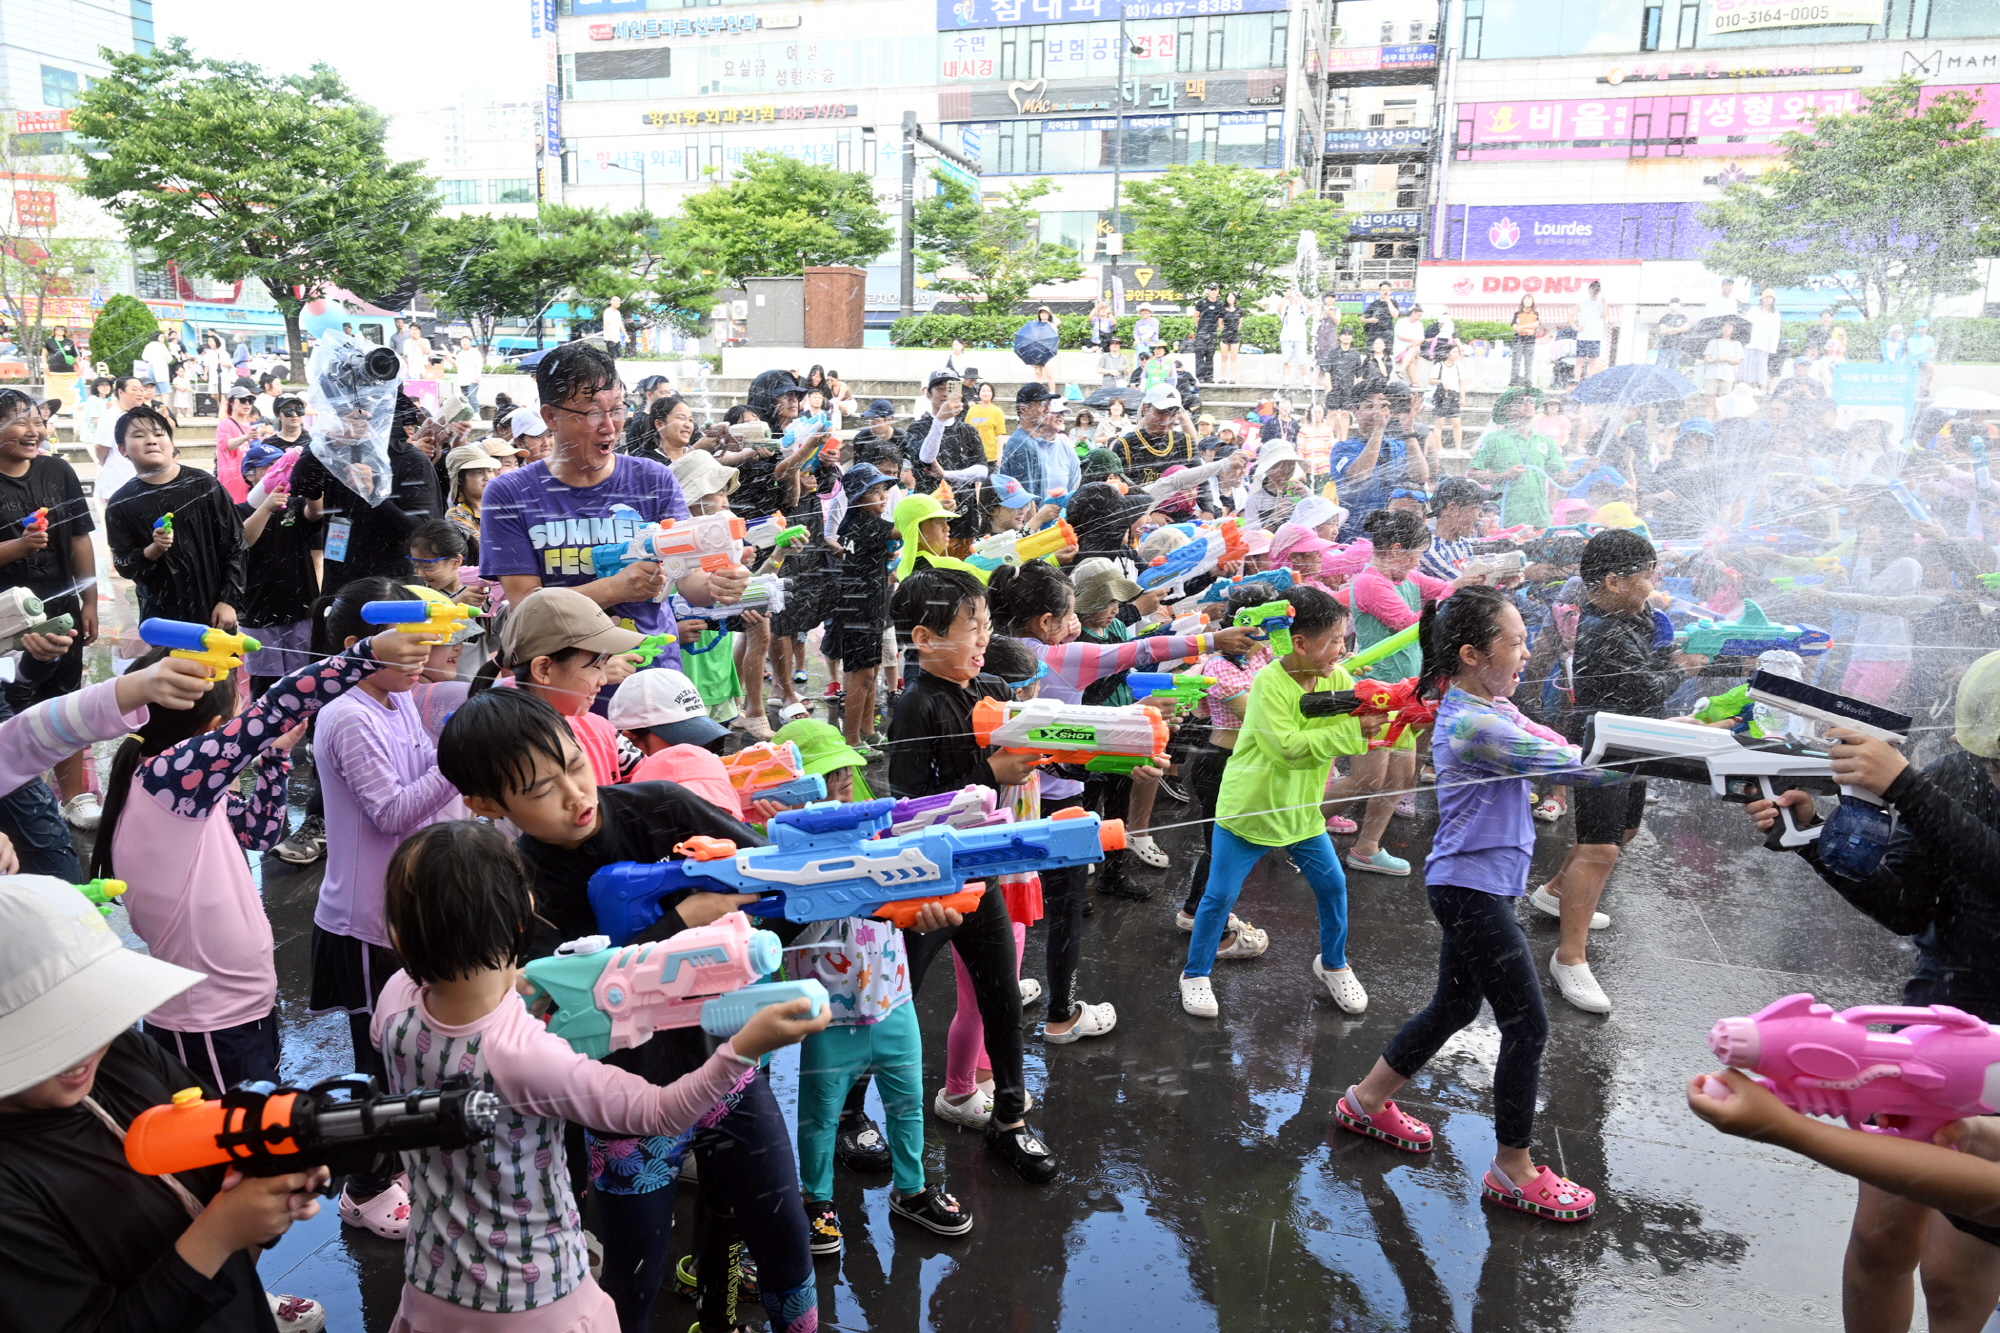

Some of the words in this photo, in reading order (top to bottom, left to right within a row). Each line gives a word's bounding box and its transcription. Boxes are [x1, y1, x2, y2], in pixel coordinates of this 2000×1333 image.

[1152, 0, 1243, 16] 487-8383
[1715, 5, 1830, 29] 010-3164-0005
[952, 36, 986, 54] 수면
[1136, 34, 1175, 59] 검진
[941, 58, 994, 78] 내시경
[1947, 55, 1997, 68] MAM
[1114, 75, 1178, 110] 치과
[1186, 78, 1206, 102] 맥
[781, 102, 847, 120] 486-9975
[1021, 98, 1051, 114] MAC
[1704, 92, 1858, 127] 성형외과
[1528, 102, 1611, 138] 비올
[1363, 130, 1430, 147] 상상아이
[1533, 220, 1593, 237] Lourdes
[544, 547, 597, 577] FES
